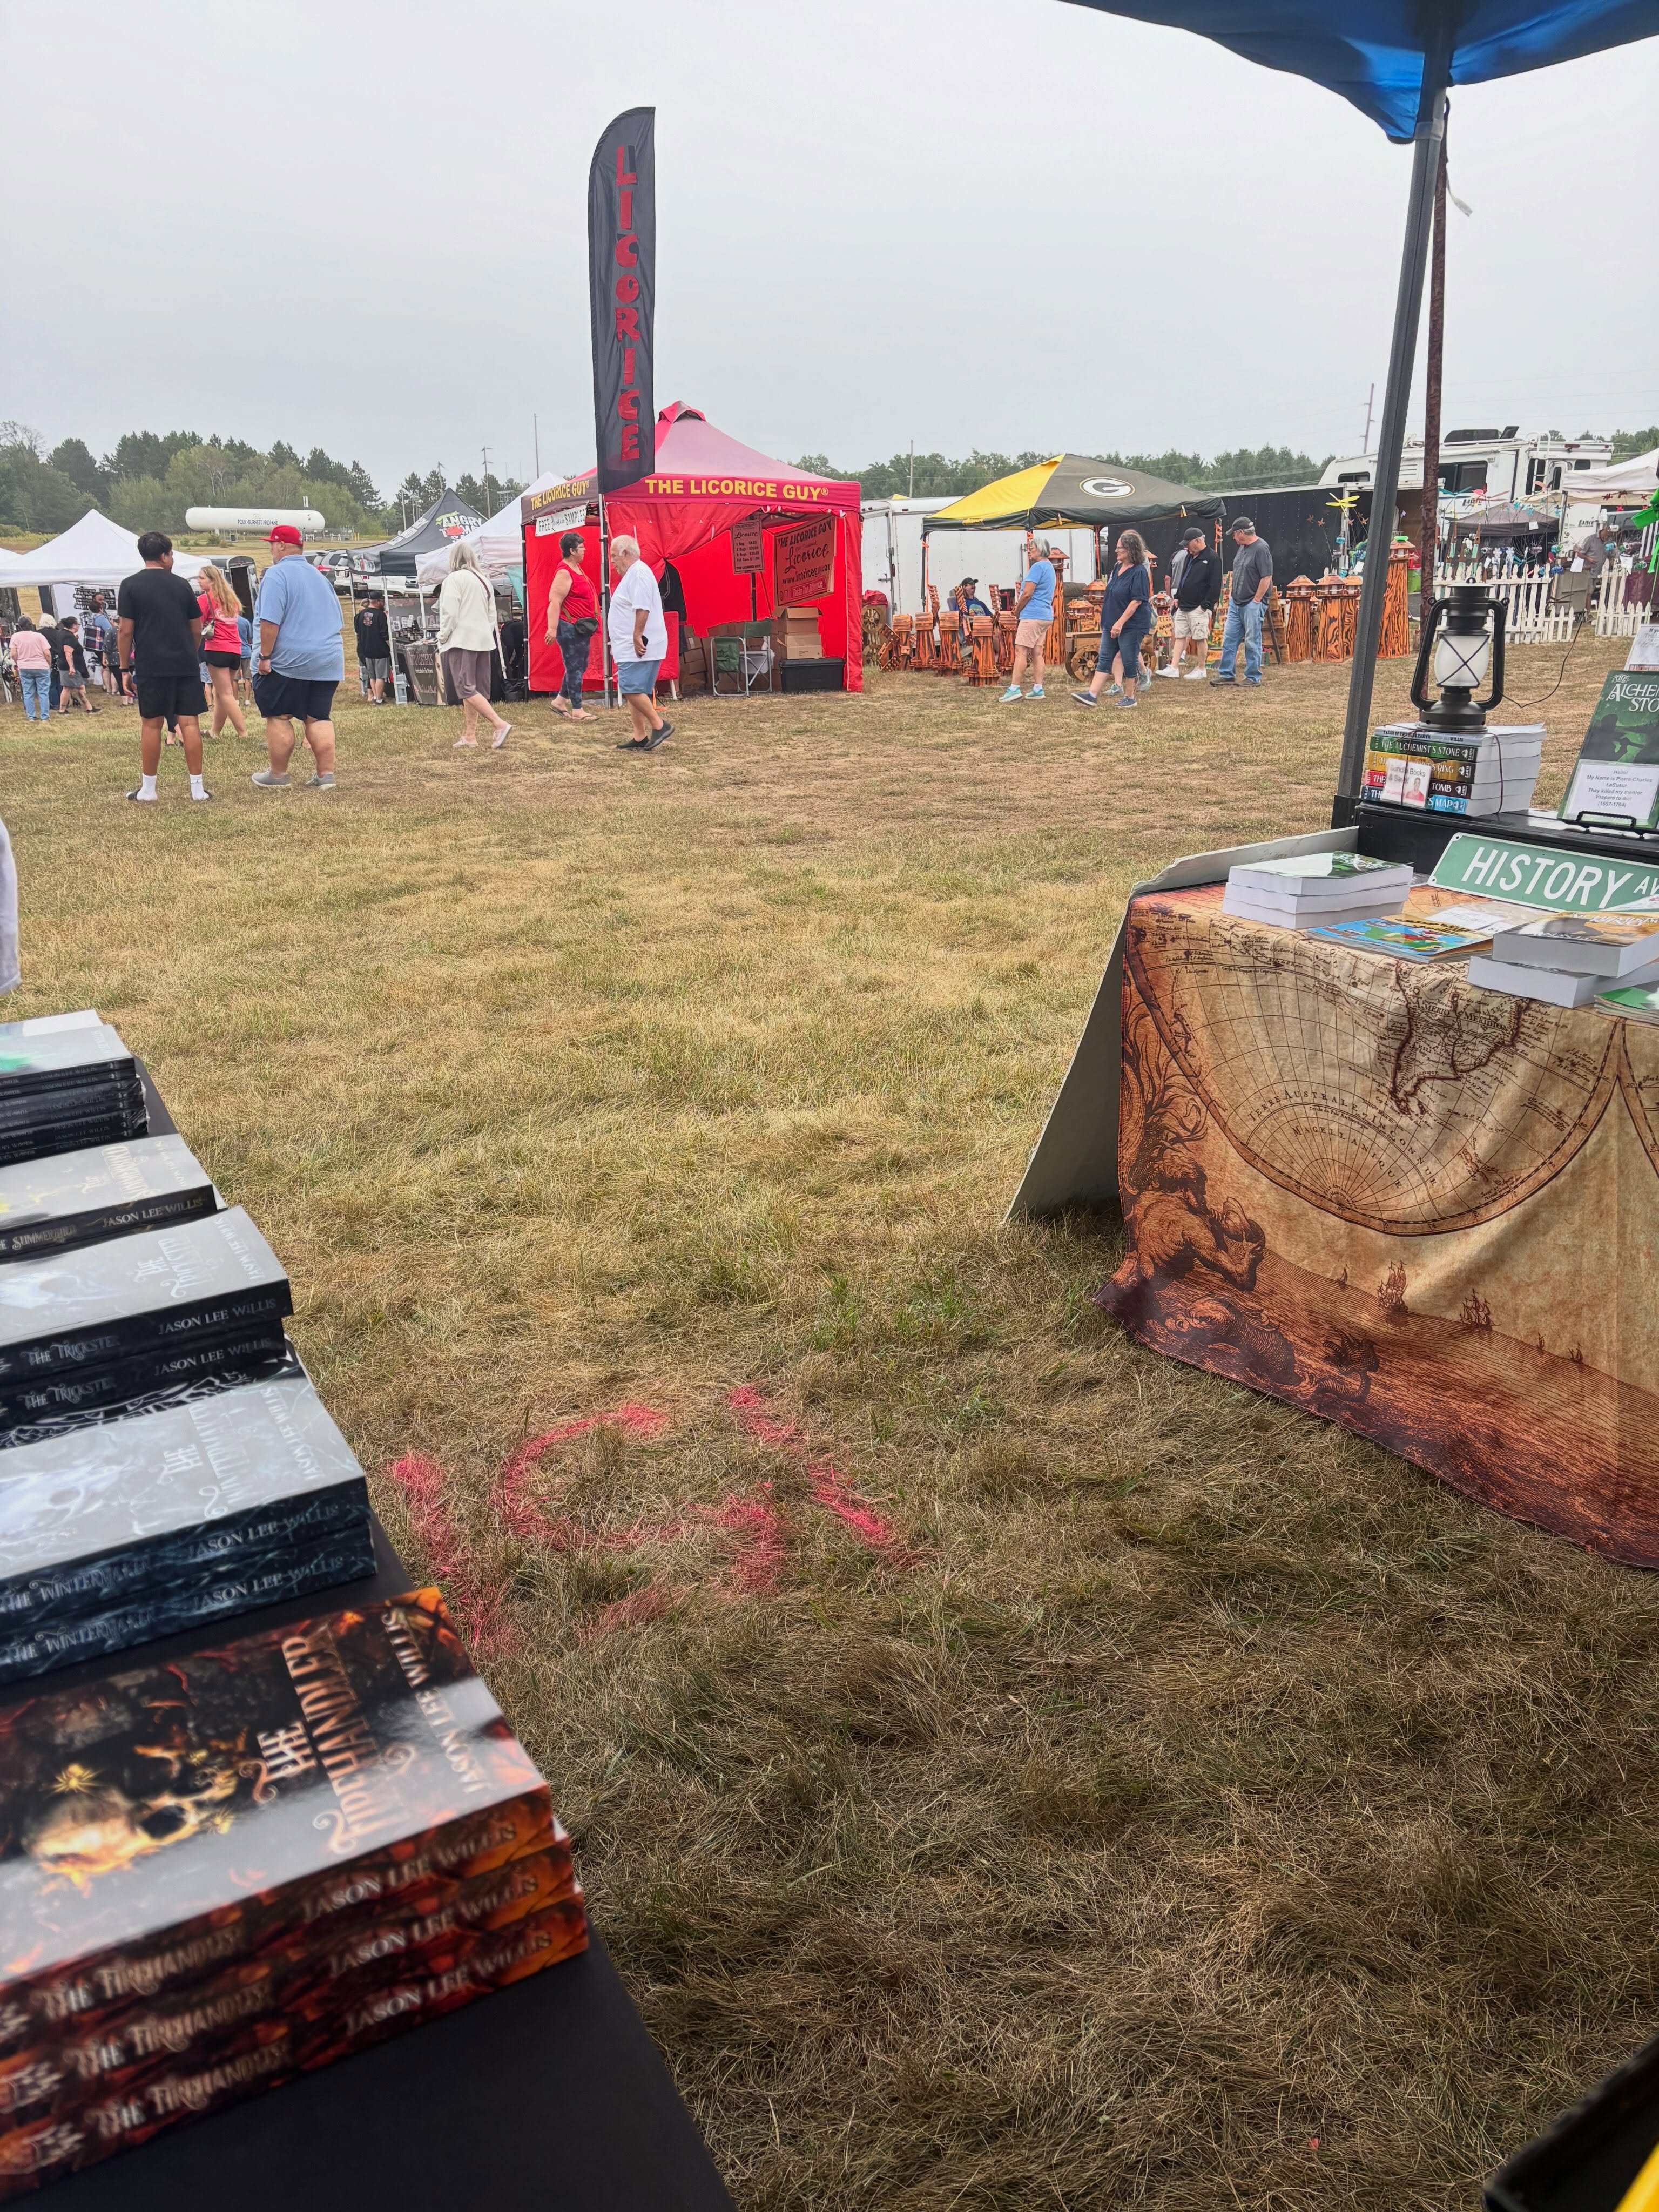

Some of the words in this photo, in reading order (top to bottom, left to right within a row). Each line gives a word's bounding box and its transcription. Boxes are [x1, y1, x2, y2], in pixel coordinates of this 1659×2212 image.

[615, 144, 641, 461] LICORICE
[531, 494, 542, 510] THE
[542, 483, 571, 506] LICORICE
[645, 479, 684, 494] THE
[690, 479, 778, 498] LICORICE
[441, 515, 482, 529] ANGRY
[539, 518, 550, 532] FREE
[778, 535, 789, 549] THE
[789, 526, 817, 547] LICORICE
[784, 544, 830, 574] Licorice
[1607, 683, 1659, 702] ALCHE
[1381, 740, 1393, 750] THE
[1395, 741, 1437, 754] ALCHEMIST'S
[1438, 745, 1460, 757] STONE
[1437, 764, 1454, 773] RING
[1373, 774, 1386, 784] THE
[1432, 782, 1452, 792] TOMB
[1410, 768, 1426, 777] Books
[1434, 797, 1453, 808] MAP
[1461, 846, 1634, 909] HISTORY
[1247, 1095, 1281, 1122] TERRE
[1284, 1089, 1358, 1111] AUSTRALE
[1291, 1125, 1402, 1189] MAGELLANIQUE
[1372, 1115, 1437, 1187] INCONNUE
[103, 1212, 139, 1228] JASON
[142, 1207, 163, 1219] LEE
[163, 1196, 204, 1215] WILLIS
[158, 1318, 202, 1336] JASON
[205, 1309, 229, 1324] LEE
[232, 1297, 277, 1318] WILLIS
[19, 1344, 52, 1366] THE
[154, 1358, 197, 1377] JASON
[200, 1348, 225, 1365] LEE
[227, 1337, 271, 1357] WILLIS
[16, 1386, 48, 1410] THE
[188, 1532, 244, 1558] JASON
[247, 1520, 278, 1542] LEE
[279, 1502, 340, 1532] WILLIS
[193, 1583, 247, 1612] JASON
[251, 1572, 283, 1594] LEE
[284, 1554, 345, 1584] WILLIS
[381, 1607, 431, 1690] WILLIS
[415, 1684, 455, 1729] LEE
[281, 1624, 417, 1855] FIREHANDLER
[239, 1721, 319, 1804] THE
[436, 1725, 493, 1795] JASON
[302, 1877, 382, 1922] JASON
[387, 1853, 432, 1887] LEE
[435, 1823, 516, 1867] WILLIS
[327, 1930, 408, 1979] JASON
[410, 1907, 456, 1941] LEE
[456, 1876, 539, 1921] WILLIS
[31, 1978, 96, 2020] THE
[345, 1987, 422, 2037] JASON
[426, 1964, 470, 1999] LEE
[471, 1930, 553, 1977] WILLIS
[63, 2035, 126, 2079] THE
[83, 2095, 146, 2139] THE
